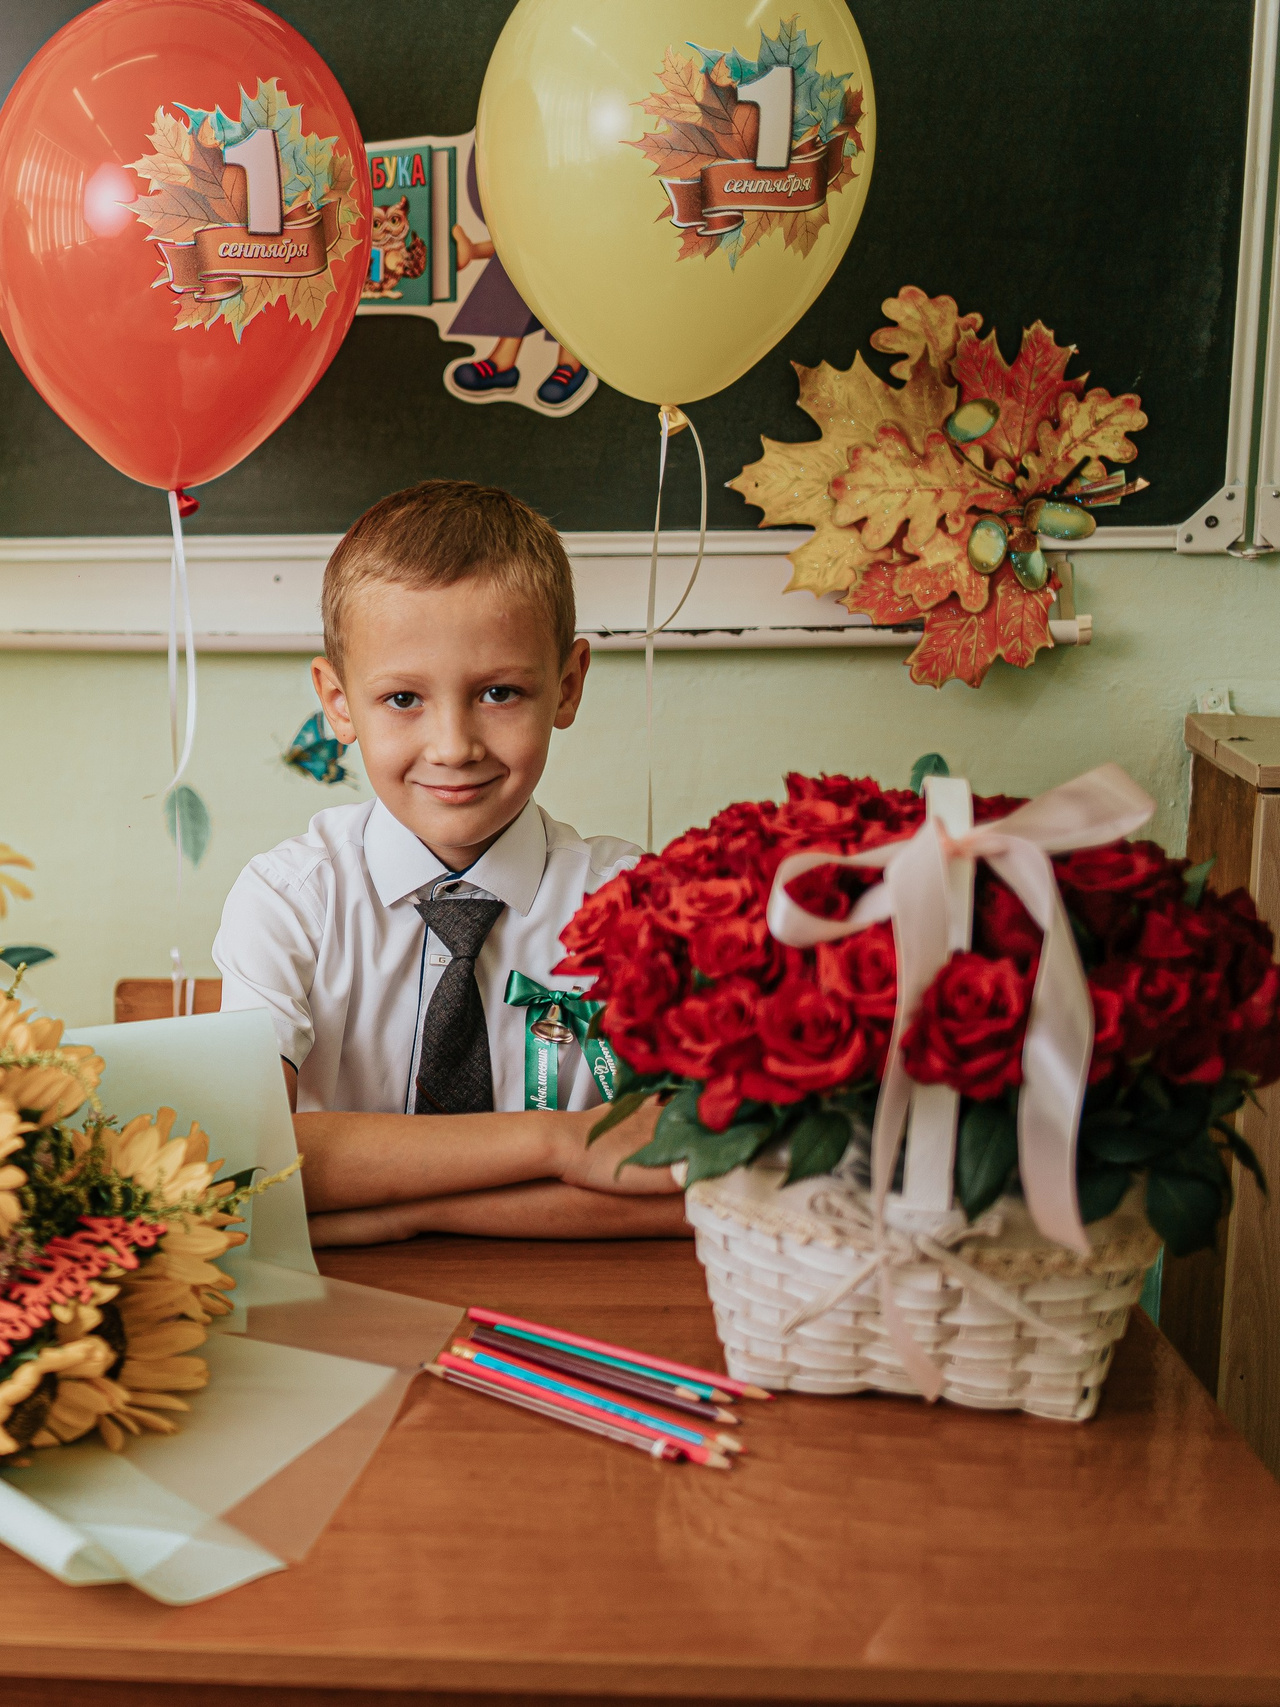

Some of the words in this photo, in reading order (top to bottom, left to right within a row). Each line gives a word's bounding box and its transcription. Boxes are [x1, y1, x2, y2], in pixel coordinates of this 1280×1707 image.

[736, 65, 795, 171] 1
[222, 128, 283, 235] 1
[723, 172, 813, 198] сентября
[218, 237, 310, 263] сентября
